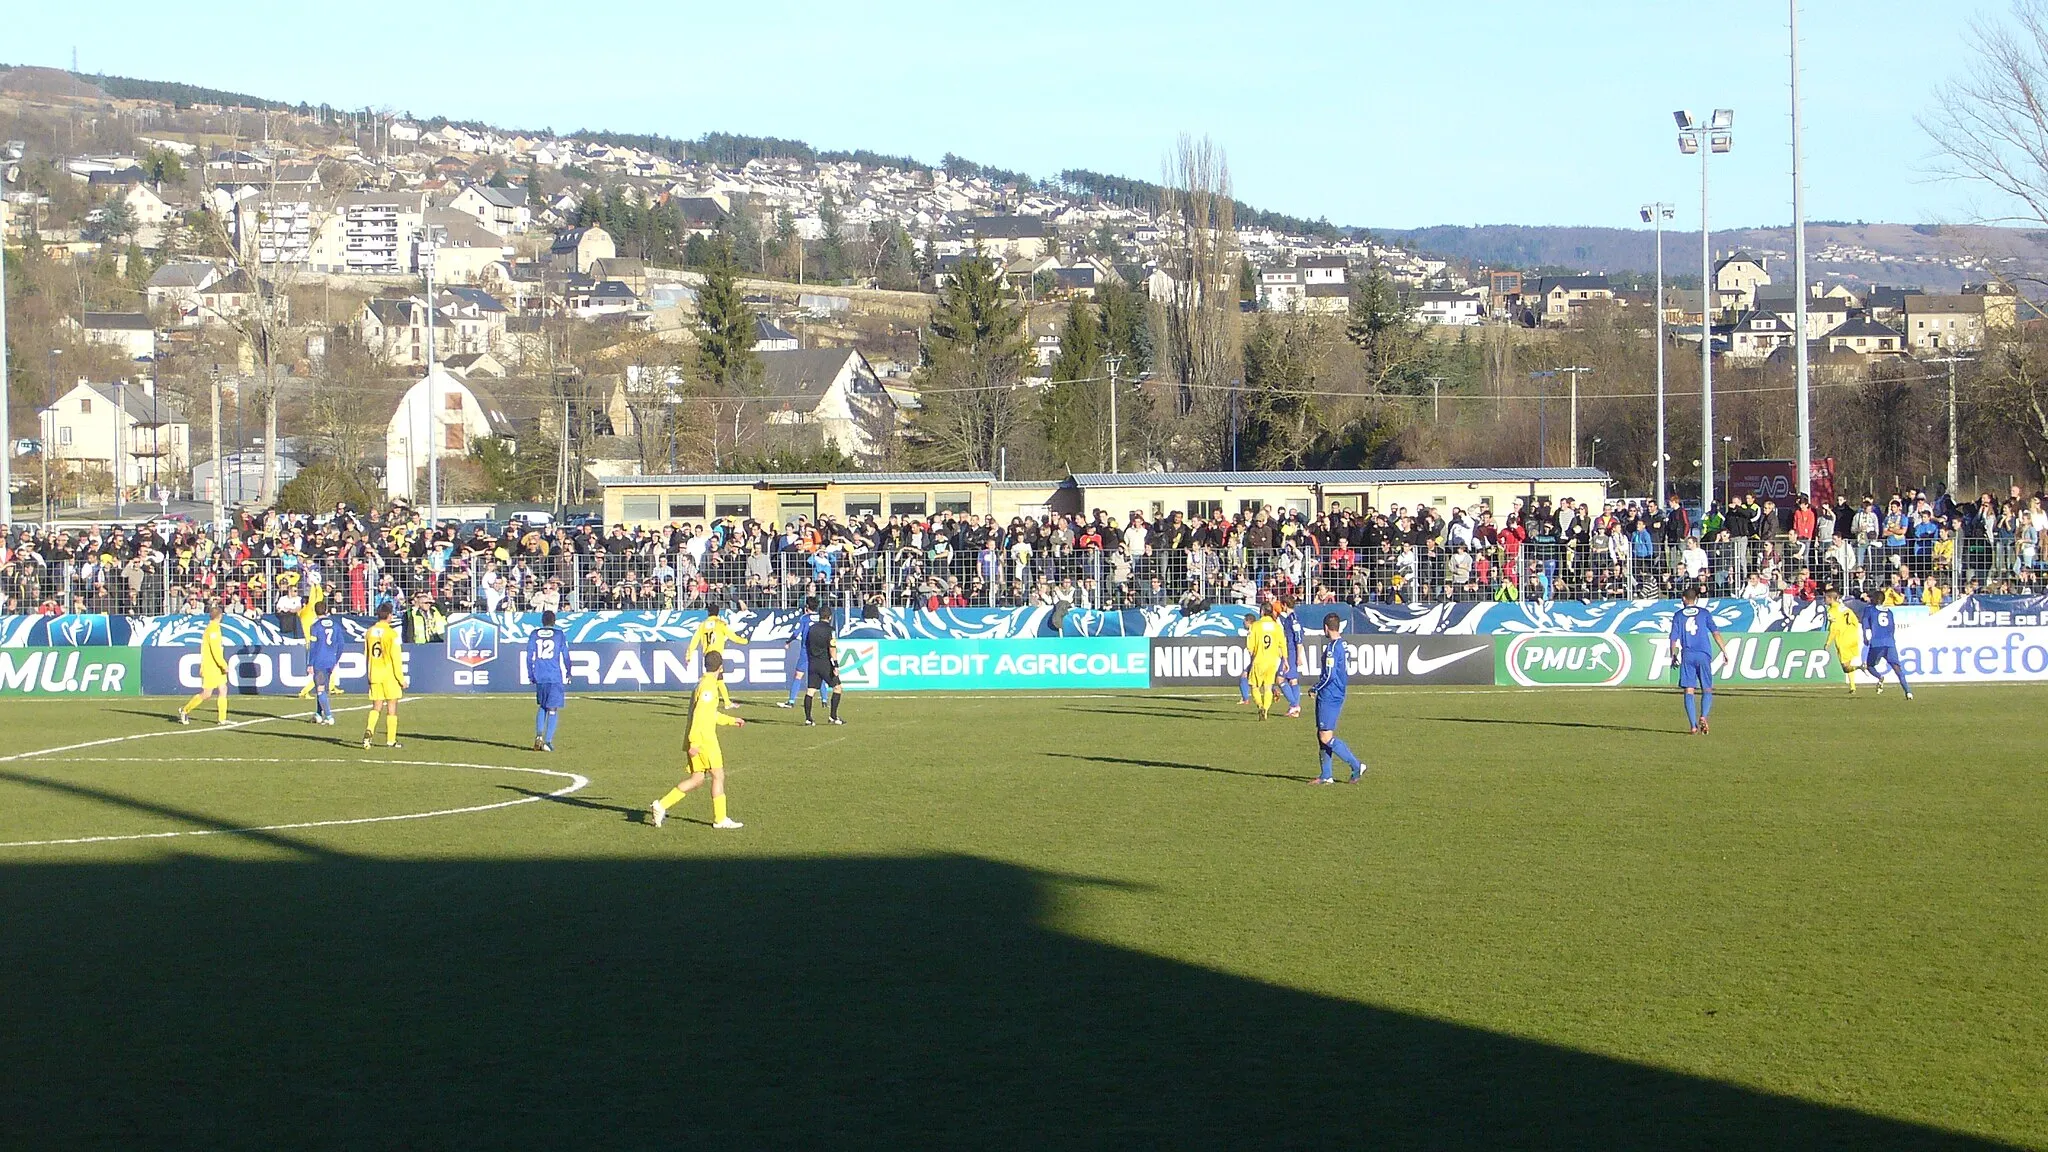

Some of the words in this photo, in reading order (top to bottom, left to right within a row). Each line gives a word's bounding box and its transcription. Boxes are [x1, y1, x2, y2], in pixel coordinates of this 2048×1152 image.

[1685, 617, 1699, 636] 4
[1877, 613, 1889, 627] 6
[324, 629, 334, 646] 7
[1263, 635, 1272, 650] 9
[372, 641, 383, 658] 6
[454, 649, 492, 659] FFF
[535, 639, 555, 660] 12
[880, 651, 990, 676] CRÉDIT
[994, 653, 1148, 675] AGRICOLE
[1523, 646, 1587, 671] PMU
[178, 652, 411, 688] COUP
[454, 670, 490, 686] DE
